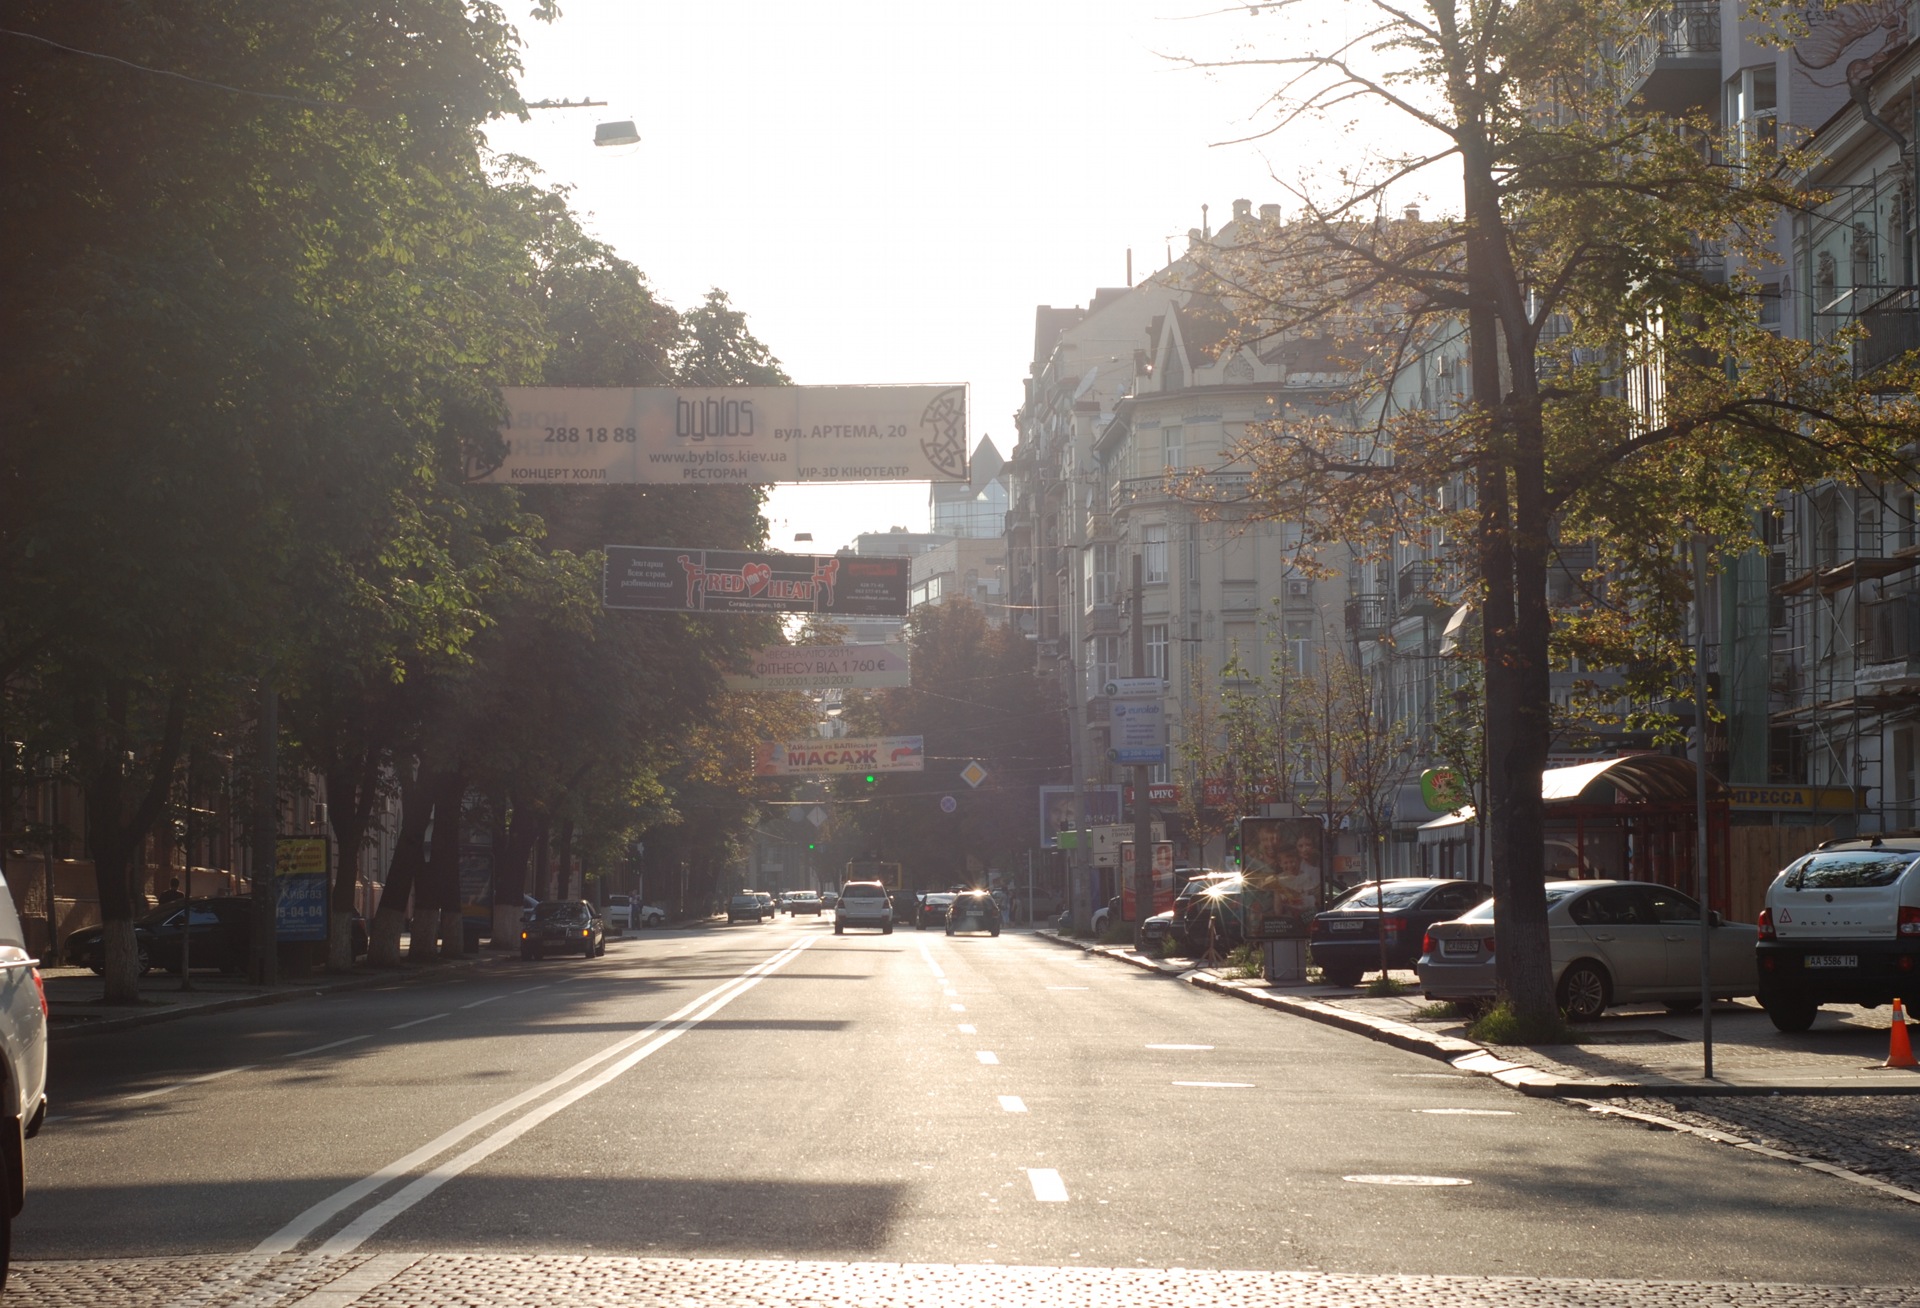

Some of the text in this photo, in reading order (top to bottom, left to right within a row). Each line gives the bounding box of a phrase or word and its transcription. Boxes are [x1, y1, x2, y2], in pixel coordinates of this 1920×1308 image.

[676, 396, 754, 442] byblos
[544, 427, 637, 442] 288 18 88
[774, 424, 908, 443] вул. АРТЕМА, 20
[649, 450, 788, 466] www.byblos.kiev.ua
[511, 468, 607, 480] КОНЦЕРТ ХОЛЛ
[683, 468, 748, 479] РЕСТОРАН
[798, 466, 909, 479] VIP-3D КІНОТЕАТР
[707, 573, 815, 599] RED HEAT
[756, 661, 813, 675] ФІТНЕСУ
[816, 661, 839, 675] ВІД
[877, 660, 888, 671] €
[1128, 705, 1160, 714] eurolab
[788, 750, 877, 766] МАСАЖ
[1810, 956, 1820, 966] AA
[1823, 956, 1842, 965] 5586
